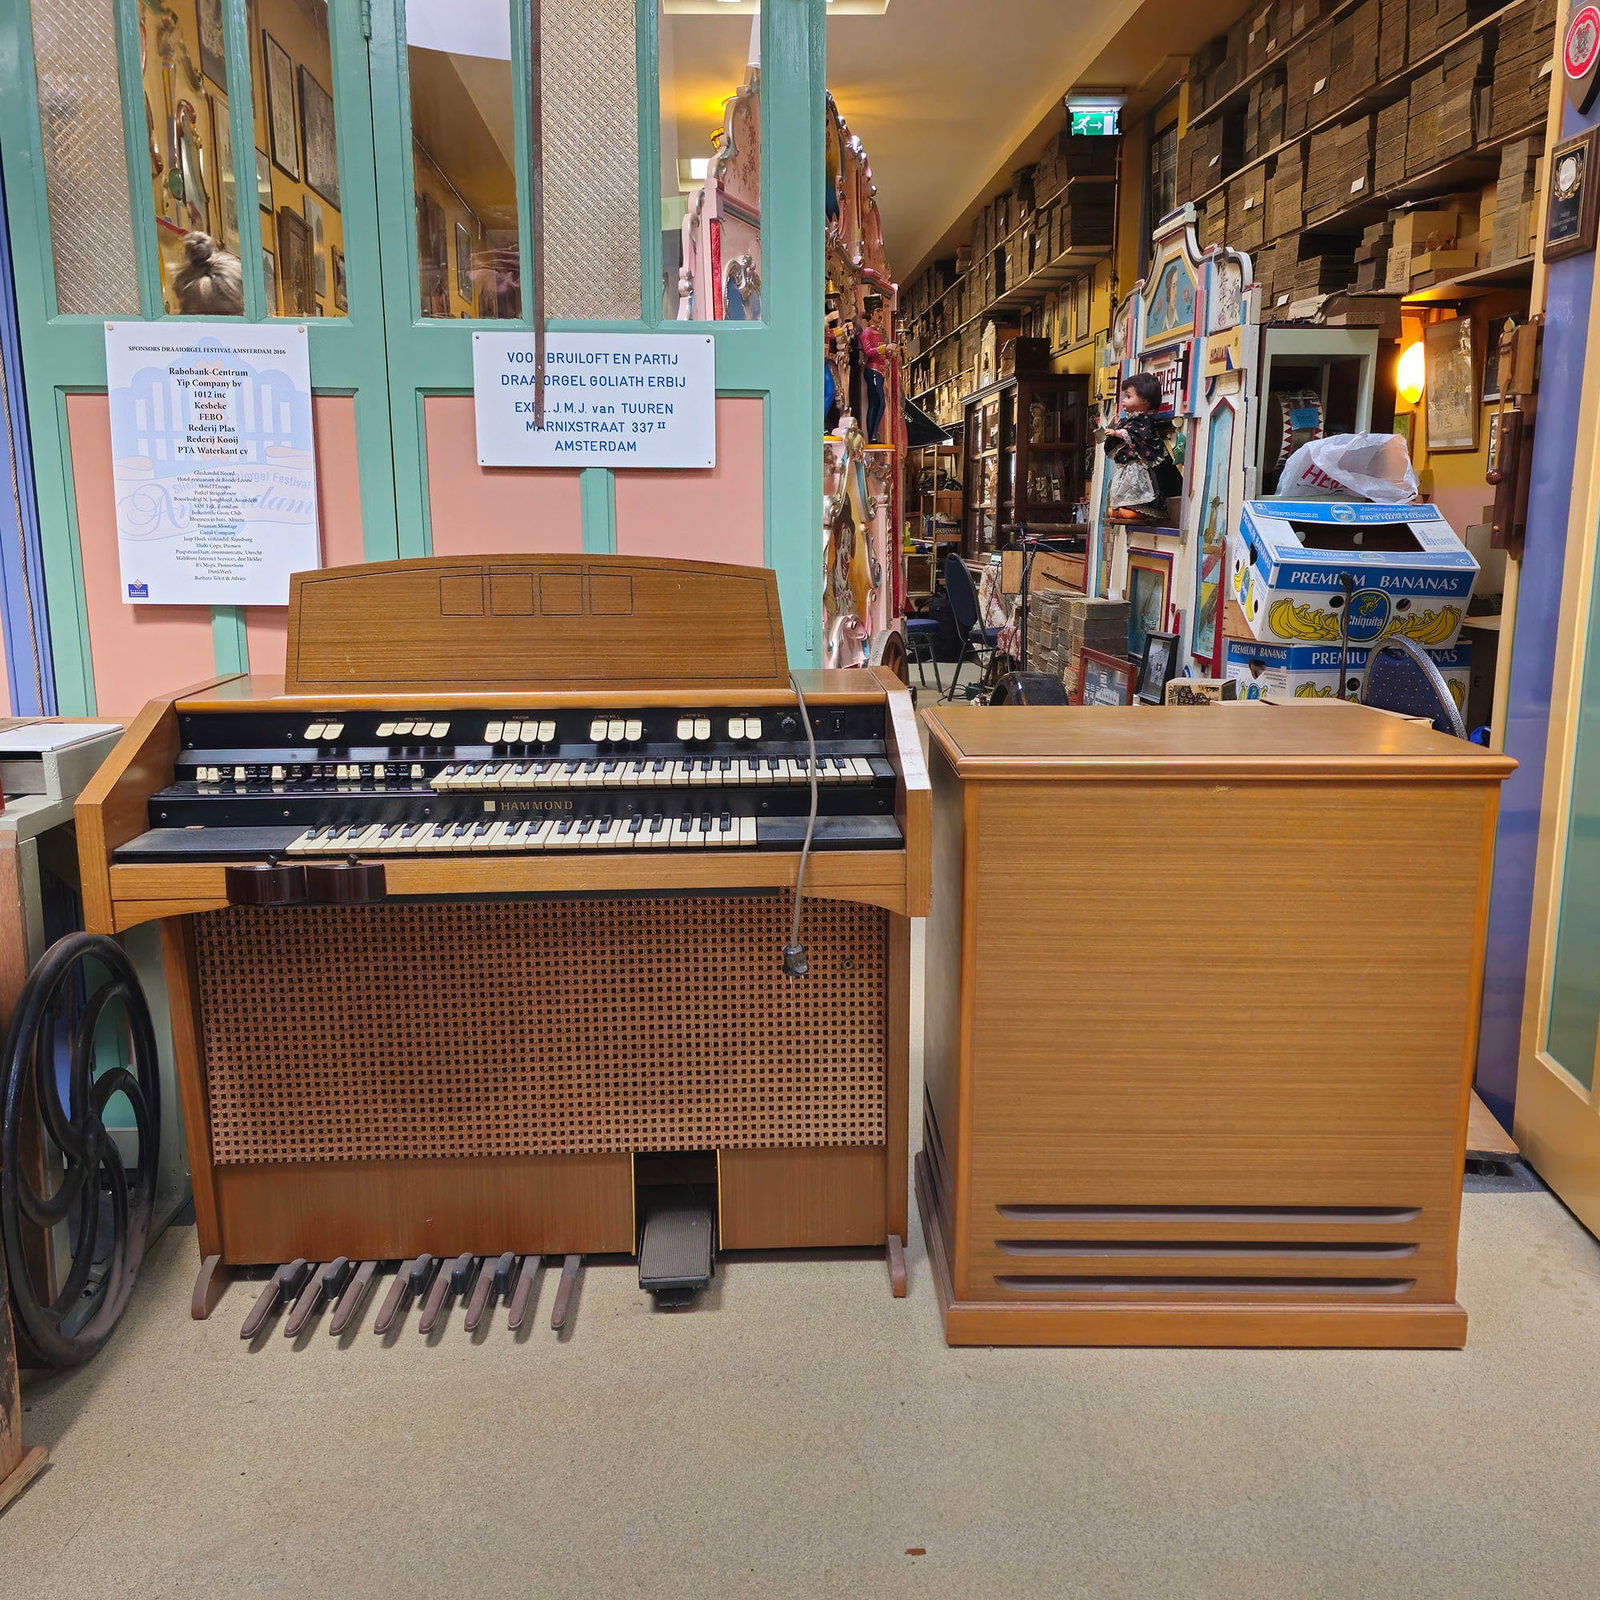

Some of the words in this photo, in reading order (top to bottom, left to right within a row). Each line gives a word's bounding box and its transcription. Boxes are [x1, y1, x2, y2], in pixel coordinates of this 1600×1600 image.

[507, 352, 535, 364] VOO
[547, 352, 610, 365] BRUILOFT
[613, 353, 631, 365] EN
[634, 353, 679, 366] PARTIJ
[169, 367, 248, 377] Rabobank-Centrum
[177, 379, 190, 389] Yip
[192, 379, 230, 389] Company
[232, 380, 242, 388] bv
[501, 375, 587, 387] DRAAORGEL
[589, 376, 644, 388] GOLIATH
[648, 376, 686, 388] ERBIJ
[194, 390, 212, 399] 1012
[214, 391, 226, 399] inc
[194, 401, 227, 410] Kesbeke
[515, 401, 551, 413] EX.
[592, 405, 615, 414] van
[622, 402, 674, 414] TUUREN
[199, 413, 223, 421] FEBO
[188, 424, 217, 434] Rederij
[219, 424, 236, 433] Plas
[631, 421, 654, 433] 337
[186, 435, 215, 445] Rederij
[217, 436, 239, 446] Kooij
[555, 440, 637, 452] AMSTERDAM
[177, 446, 196, 455] PTA
[197, 446, 238, 455] Waterkant
[1290, 571, 1366, 587] PREMIM
[1380, 575, 1459, 590] BANANAS
[1231, 643, 1256, 656] PREMIUM
[1259, 647, 1287, 661] BANANAS
[1311, 651, 1367, 665] PREMIU
[500, 800, 573, 811] HAMMOND
